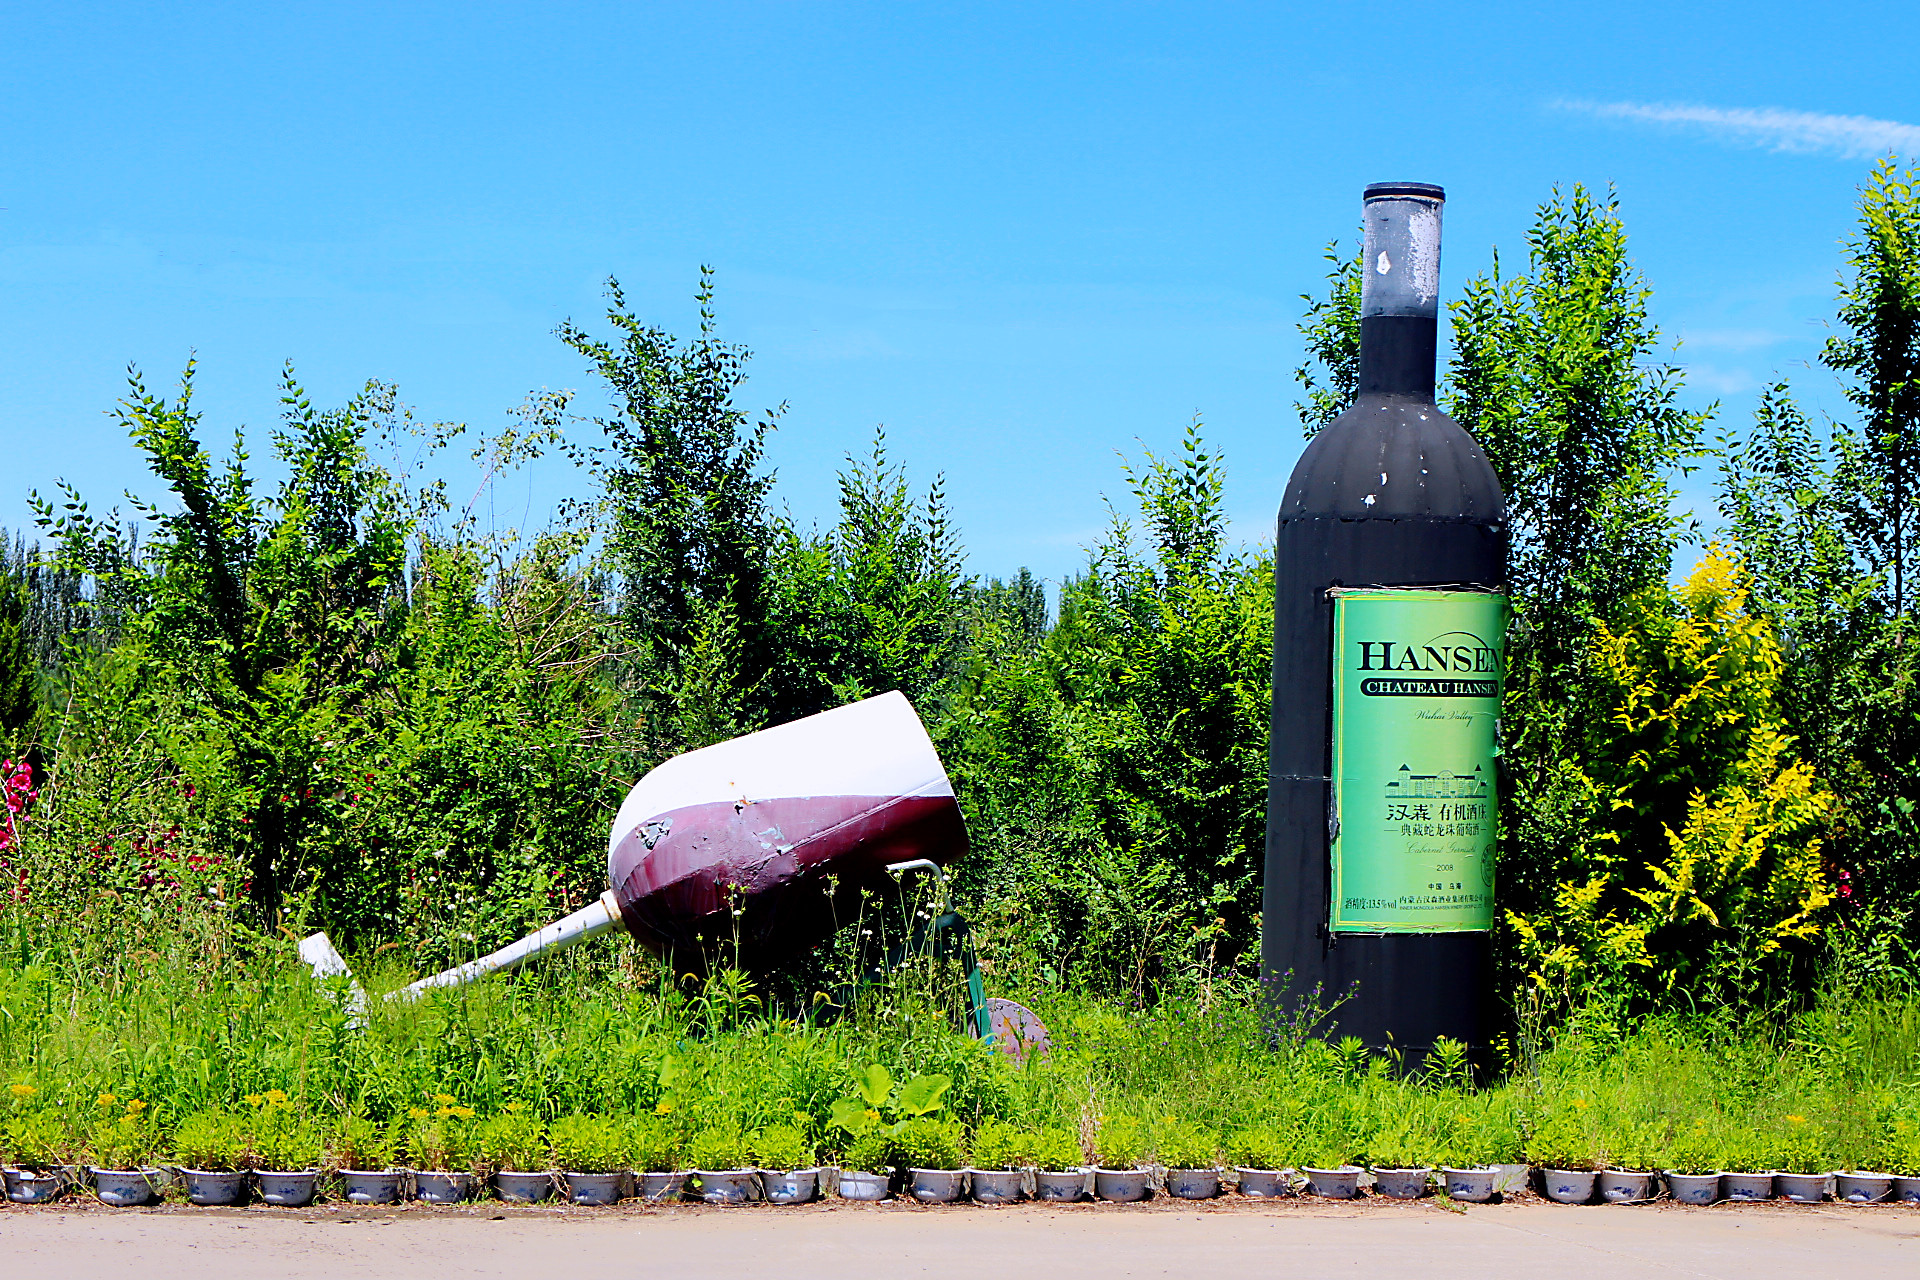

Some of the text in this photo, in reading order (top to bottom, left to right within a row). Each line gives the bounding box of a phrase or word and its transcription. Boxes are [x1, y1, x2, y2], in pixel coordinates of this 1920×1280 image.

[1357, 641, 1500, 672] HANSEN
[1366, 682, 1497, 694] CHATEAU HANSEN
[1415, 708, 1474, 727] Wuhai Valley
[1386, 804, 1487, 821] 汉森 有机酒庄
[1436, 864, 1454, 872] 2008
